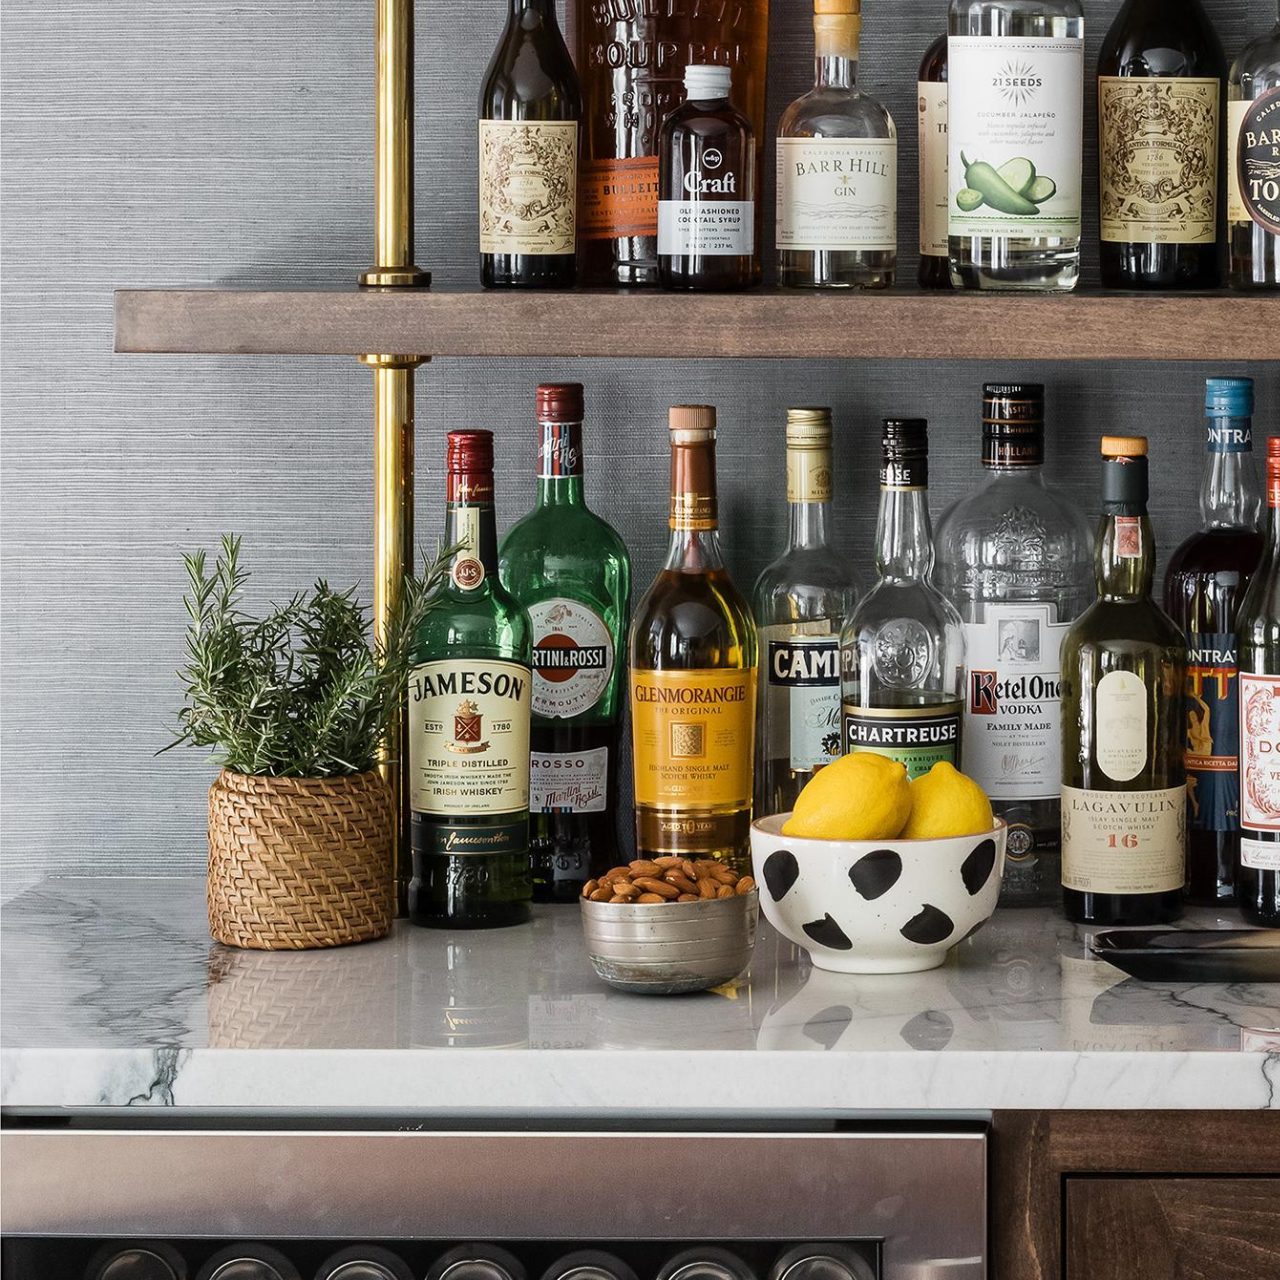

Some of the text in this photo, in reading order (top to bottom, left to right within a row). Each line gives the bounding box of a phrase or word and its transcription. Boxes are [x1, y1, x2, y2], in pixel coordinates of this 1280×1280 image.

[1005, 77, 1043, 87] SEEDS
[1128, 140, 1151, 149] ANTICA
[795, 158, 890, 177] BARR HILL
[683, 171, 736, 194] Craft
[834, 187, 856, 197] GIN
[531, 649, 603, 667] RTINI&ROSSI
[414, 671, 523, 702] JAMESON
[972, 671, 1026, 711] Ketel
[534, 693, 587, 707] ERMOUTH
[635, 684, 745, 704] GLENMORANGIE
[671, 706, 722, 715] ORIGINAL
[1000, 705, 1043, 715] VODKA
[849, 724, 957, 743] CHARTREUSE
[427, 759, 509, 767] TRIPLE DISTILLED
[531, 760, 585, 768] ROSSO
[433, 787, 504, 796] IRISH WHISKEY
[1072, 799, 1177, 814] LAGAVULIN
[1107, 834, 1138, 848] 16
